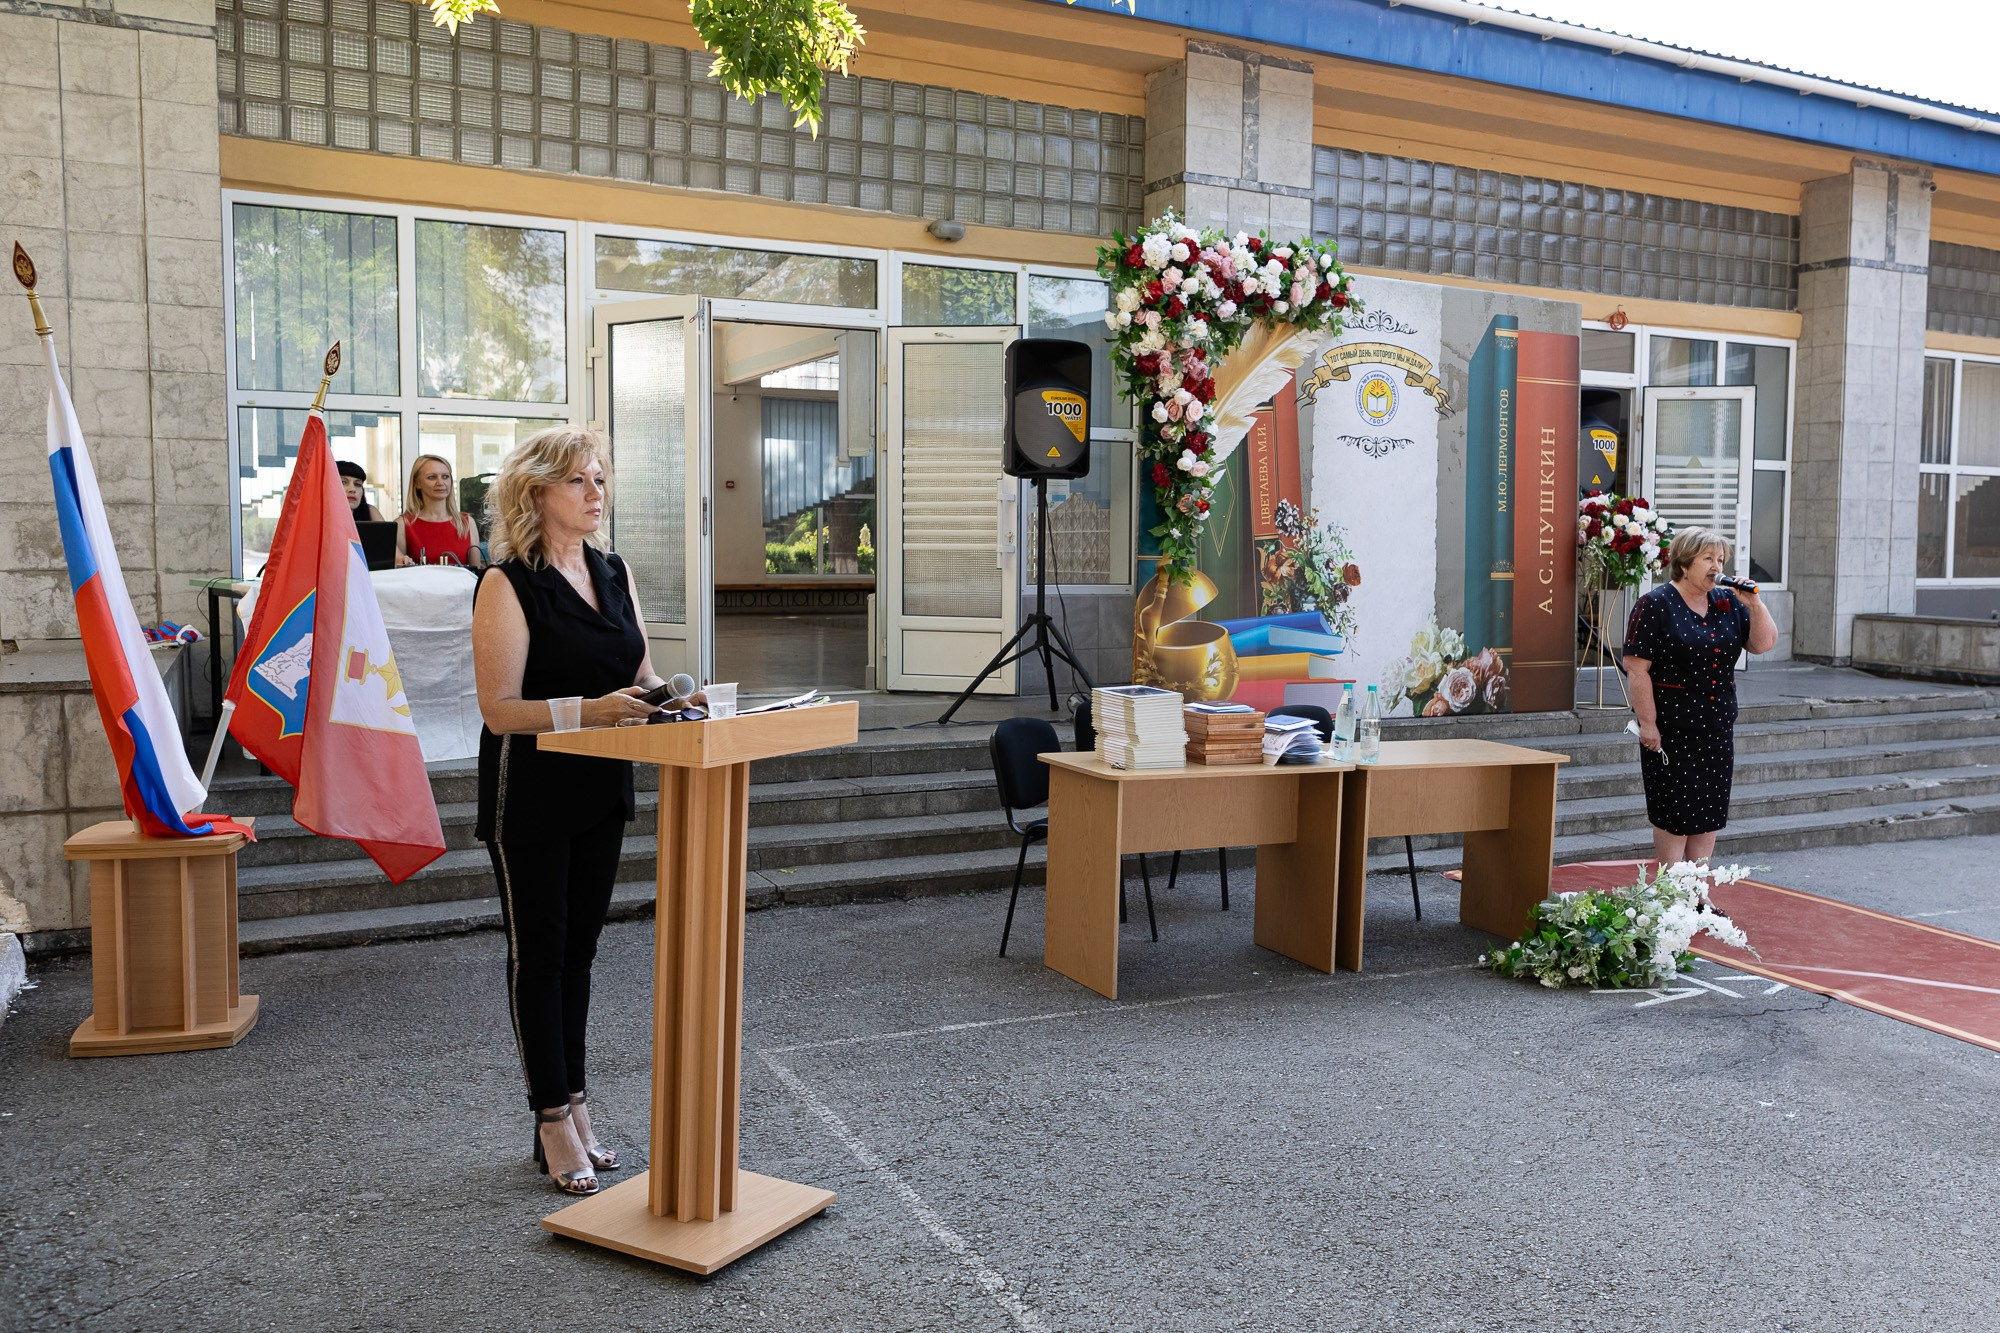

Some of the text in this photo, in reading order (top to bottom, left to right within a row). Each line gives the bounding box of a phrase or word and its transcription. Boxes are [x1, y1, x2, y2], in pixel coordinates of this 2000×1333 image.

[1330, 354, 1340, 363] ТОТ
[1340, 349, 1358, 360] САМЫЙ
[1373, 350, 1396, 359] КОТОРОГО
[1397, 353, 1405, 362] МЫ
[1046, 401, 1082, 416] 1000
[1498, 388, 1509, 512] М.Ю.ЛЕРМОНТОВ
[1593, 439, 1616, 450] 1000
[1257, 423, 1272, 525] ЦВЕТАЕВА М.И.
